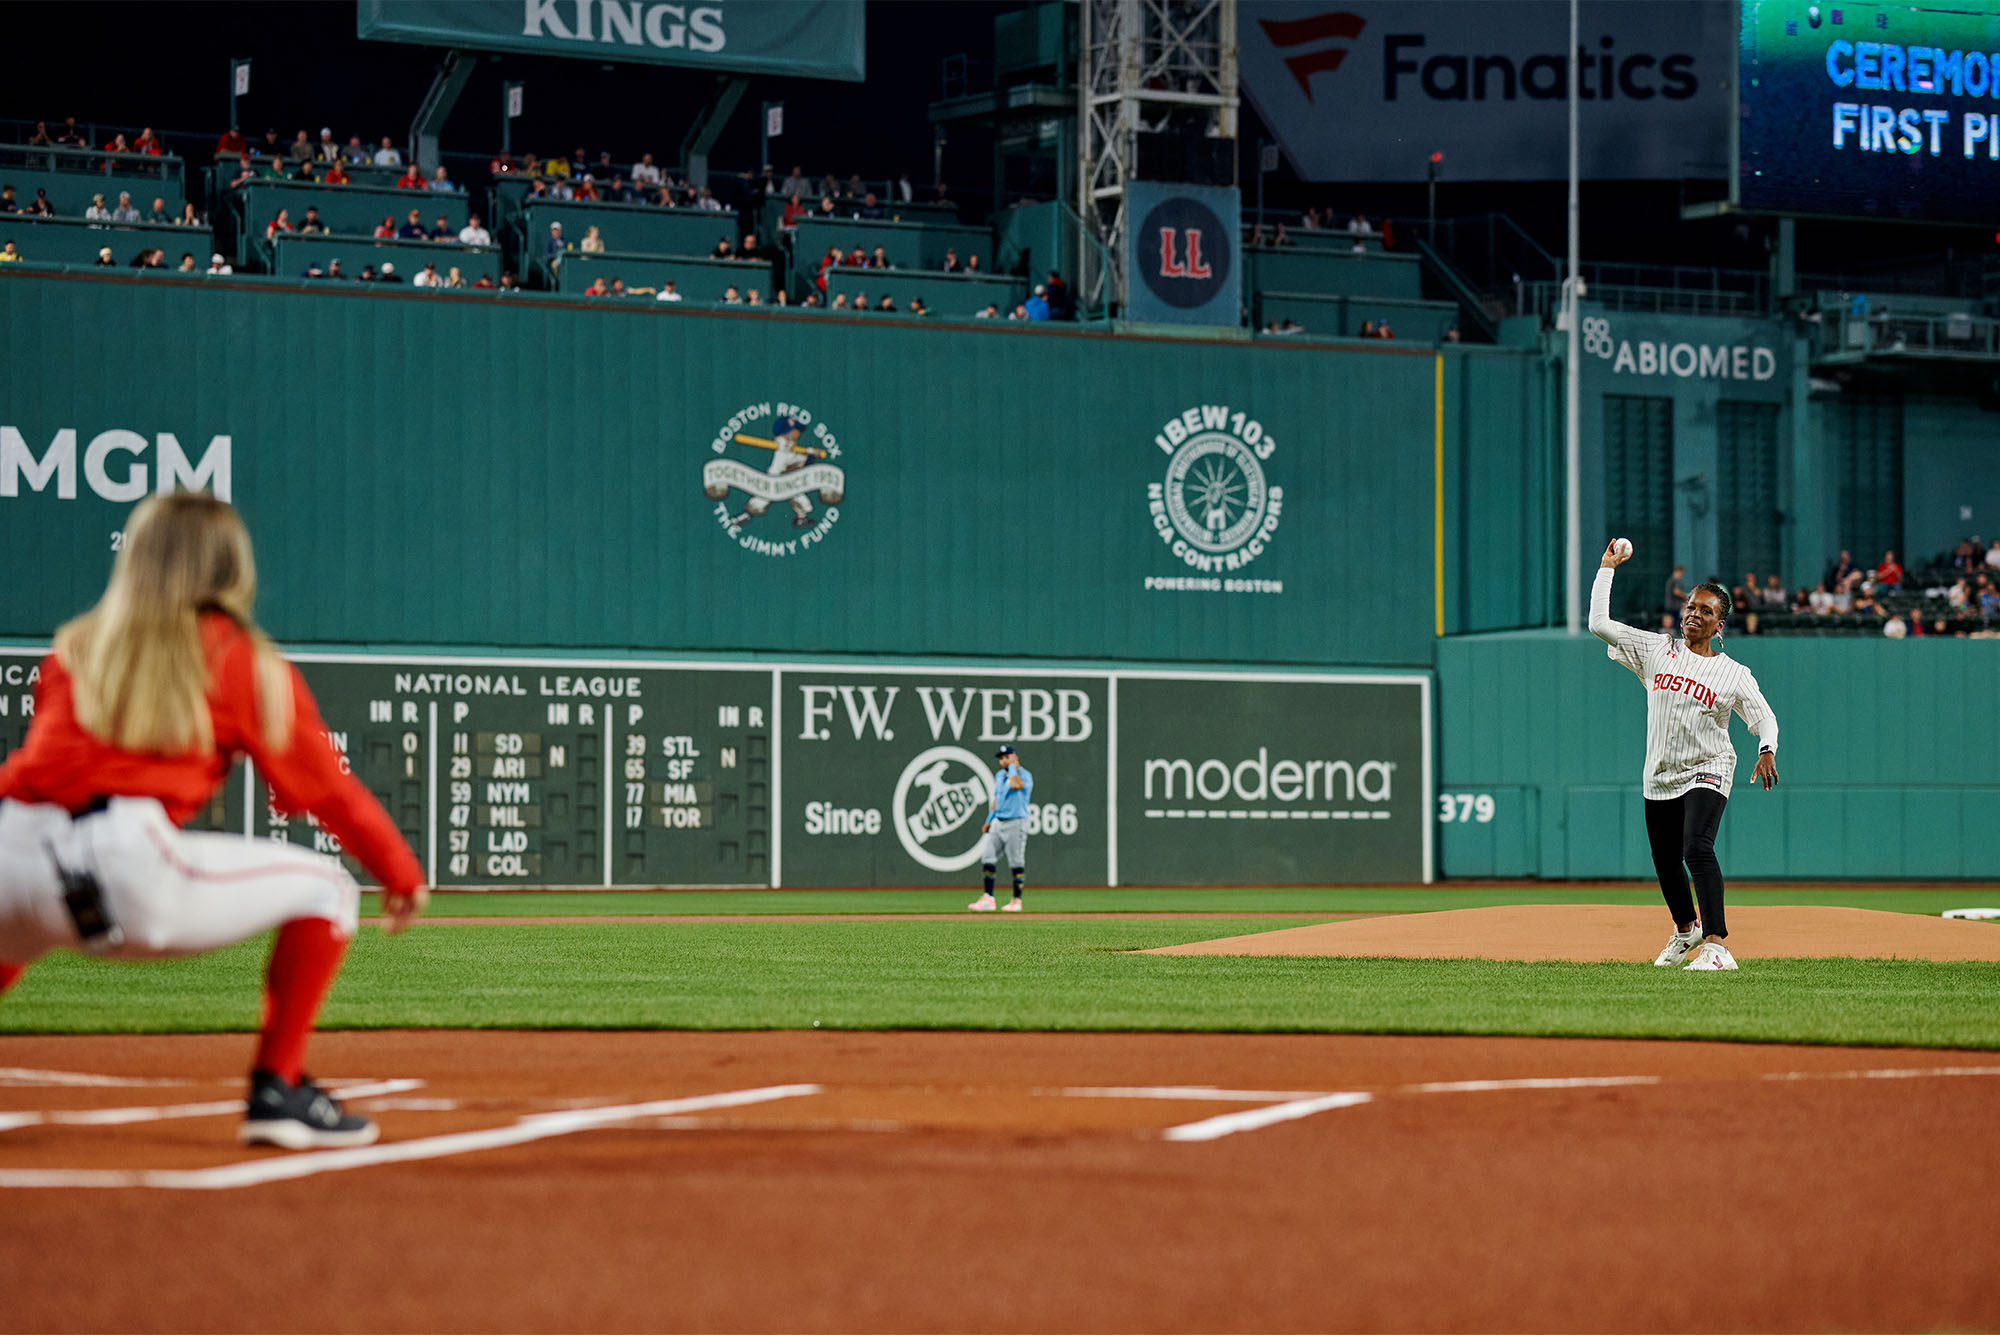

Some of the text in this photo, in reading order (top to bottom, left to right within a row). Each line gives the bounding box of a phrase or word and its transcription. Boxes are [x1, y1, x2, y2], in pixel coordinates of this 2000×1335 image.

[523, 0, 726, 52] KINGS
[1384, 34, 1698, 100] Fanatics
[1833, 102, 1950, 157] FIRST
[1160, 227, 1212, 279] LL
[1614, 340, 1776, 380] ABIOMED
[711, 402, 842, 459] BOSTON RED SOX
[1155, 405, 1276, 460] IBEW 103
[0, 426, 232, 503] MGM
[709, 466, 771, 491] TOGETHER
[774, 476, 808, 494] SINCE
[713, 502, 840, 557] THE JIMMY FUND
[1148, 483, 1175, 544] NECA
[1172, 486, 1283, 572] CONTRACTORS
[1144, 577, 1283, 593] POWERING BOSTON
[395, 673, 642, 697] NATIONAL LEAGUE
[1653, 673, 1717, 709] BOSTON
[370, 700, 419, 723] IN R
[454, 702, 594, 725] P IN R
[628, 704, 764, 728] P IN R
[917, 687, 1093, 742] WEBB
[328, 732, 347, 753] IN
[495, 734, 522, 755] SD
[626, 735, 700, 757] 39 STL
[450, 757, 525, 778] 29 ARI
[550, 745, 565, 767] N
[721, 748, 736, 768] N
[625, 759, 694, 780] 65 SF
[1145, 748, 1391, 801] moderna
[451, 782, 530, 804] 59 NYM
[625, 783, 698, 804] 77 MIA
[450, 806, 525, 827] 47 MIL
[626, 806, 701, 828] 17 TOR
[805, 801, 1078, 835] Since 866
[921, 786, 975, 832] WEBB
[1439, 794, 1495, 822] 379
[314, 831, 342, 853] KC
[450, 831, 528, 852] 57 LAD
[450, 854, 528, 876] 47 COL
